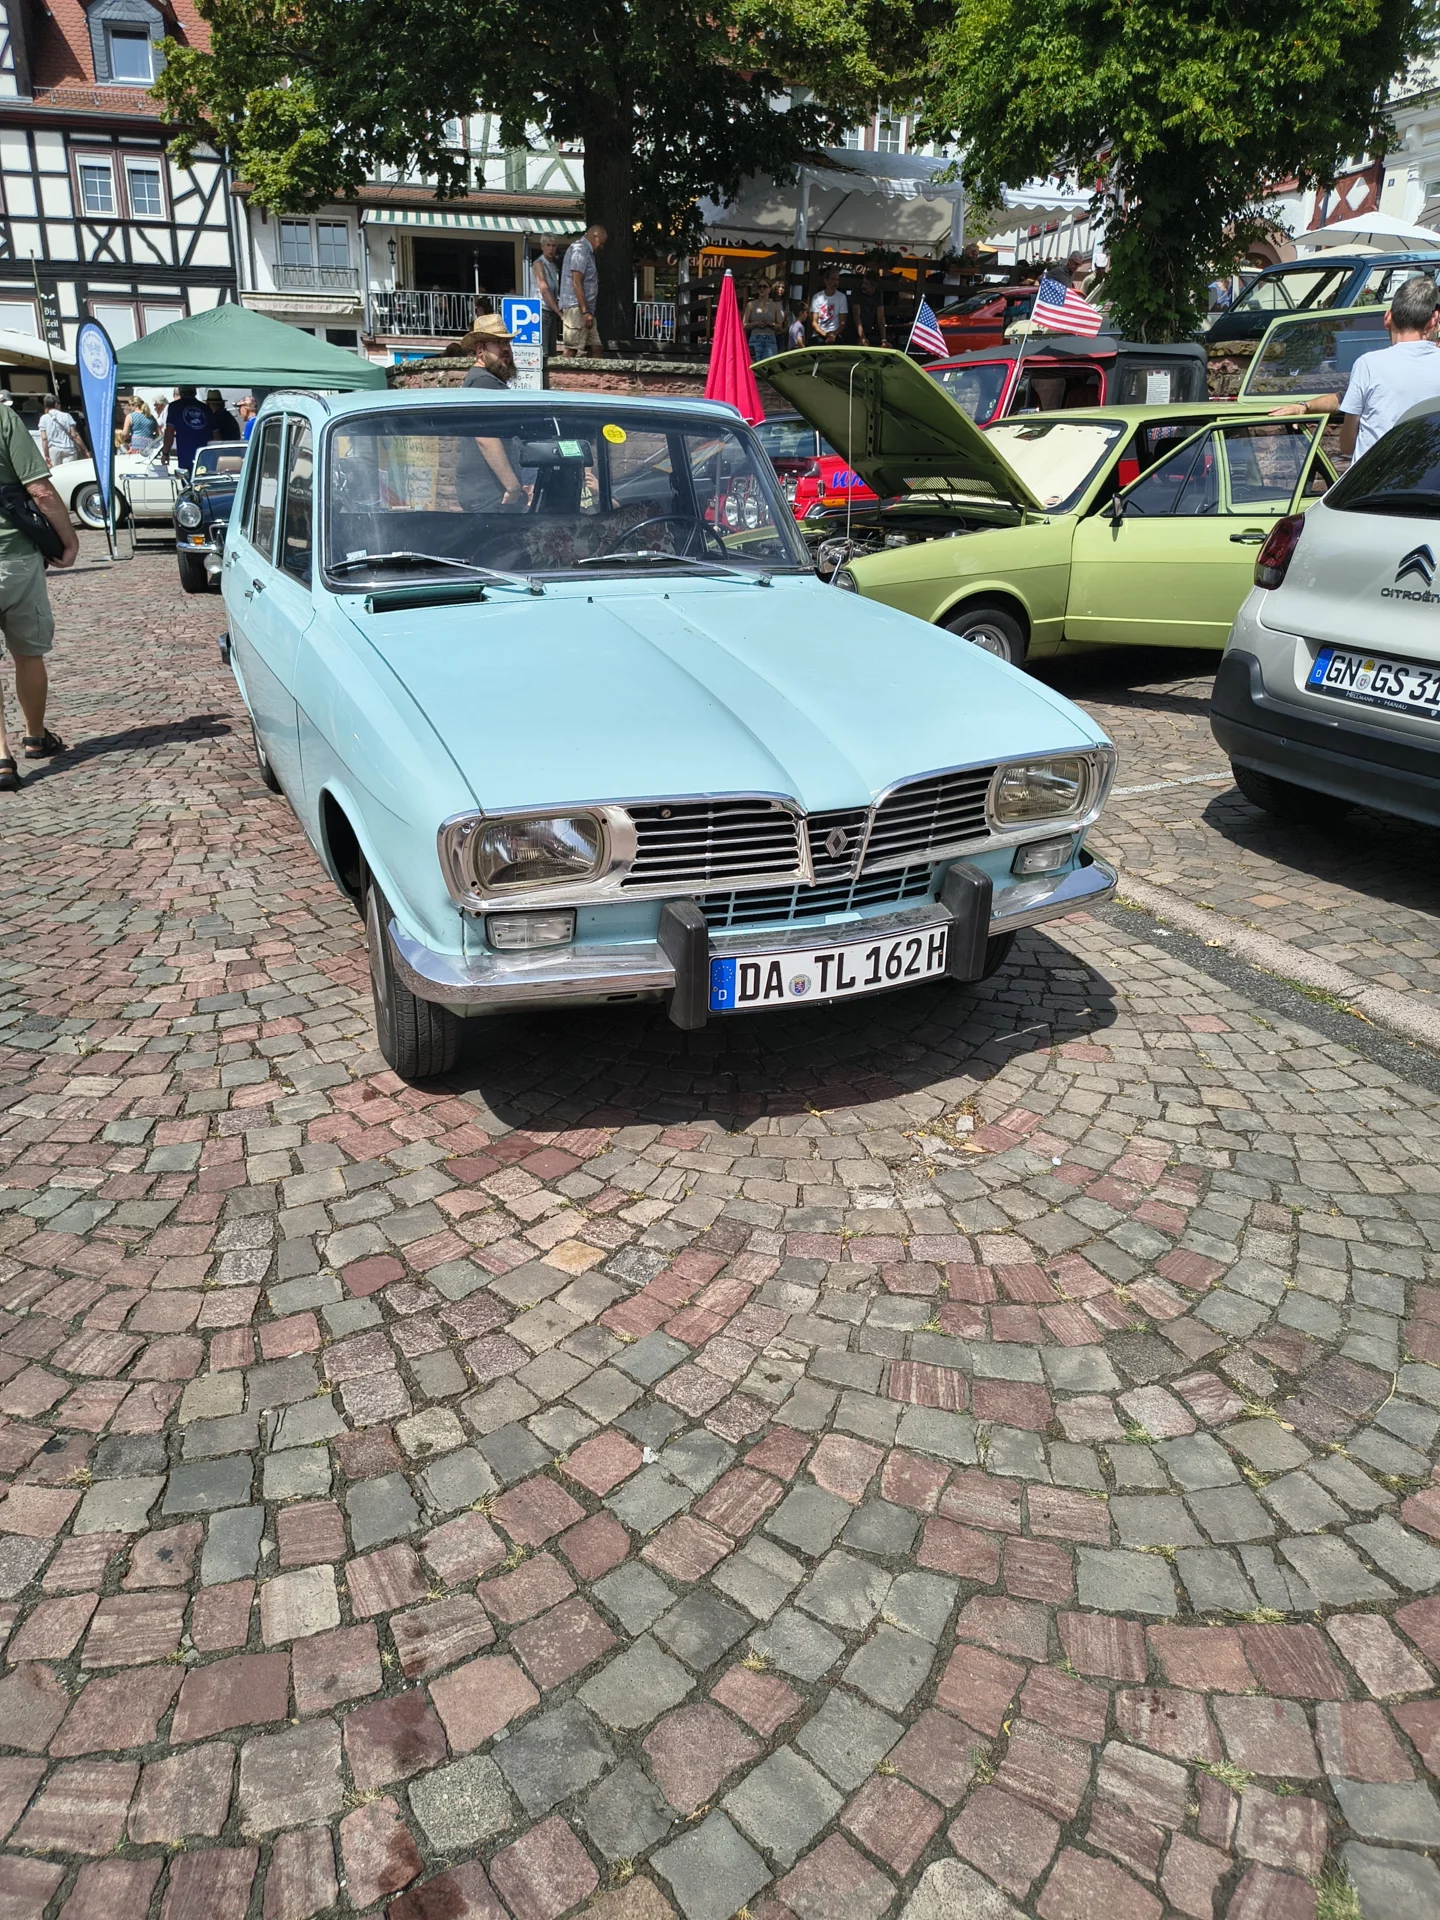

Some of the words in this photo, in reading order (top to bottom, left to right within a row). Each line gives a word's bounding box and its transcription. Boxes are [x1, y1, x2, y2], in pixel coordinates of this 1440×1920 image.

[511, 304, 532, 334] P
[1326, 655, 1362, 687] GN
[1371, 664, 1410, 697] GS
[1409, 671, 1440, 706] 31
[738, 960, 784, 1002] DA
[814, 952, 856, 993] TL
[863, 931, 946, 986] 162H
[718, 989, 726, 1001] D
